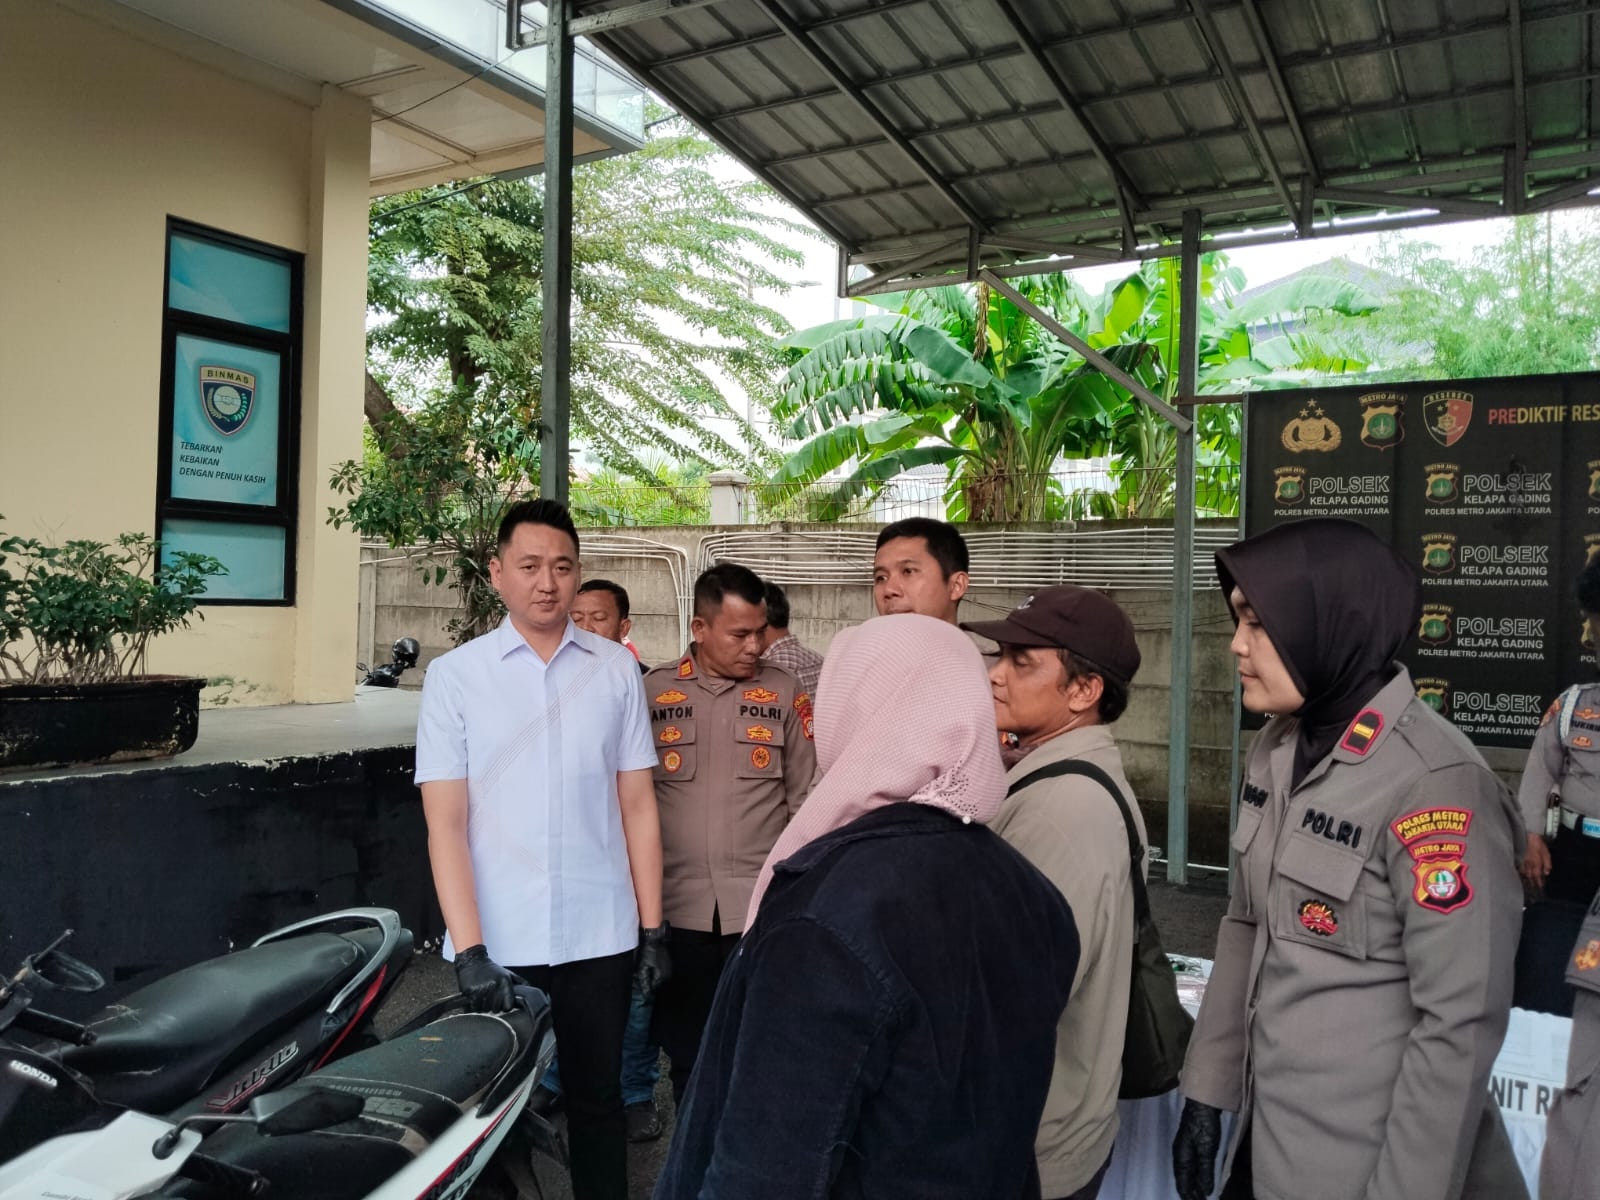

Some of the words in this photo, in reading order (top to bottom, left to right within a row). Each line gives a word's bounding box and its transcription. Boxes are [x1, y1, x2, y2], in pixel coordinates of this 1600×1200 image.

[207, 369, 249, 384] BINMAS
[1488, 406, 1567, 425] PREDIKTIF
[180, 441, 223, 454] TEBARKAN
[179, 454, 220, 466] KEBAIKAN
[179, 467, 214, 479] DENGAN
[215, 471, 242, 481] PENUH
[243, 475, 266, 484] KASIH
[1463, 473, 1552, 492] POLSEK
[1309, 476, 1390, 494] POLSEK
[1310, 497, 1348, 505] KELAPA
[1350, 496, 1389, 504] GADING
[1464, 495, 1506, 504] KELAPA
[1508, 494, 1551, 503] GADING
[1274, 508, 1302, 516] POLRES
[1364, 507, 1390, 515] UTARA
[1425, 508, 1456, 516] POLRES
[1457, 507, 1484, 515] METRO
[1486, 507, 1522, 515] JAKARTA
[1523, 506, 1552, 514] UTARA
[1460, 546, 1549, 564] POLSEK
[1461, 566, 1503, 575] KELAPA
[1505, 567, 1548, 576] GADING
[1422, 578, 1452, 586] POLRES
[1482, 579, 1519, 587] JAKARTA
[1520, 579, 1549, 587] UTARA
[1456, 617, 1545, 637] POLSEK
[1457, 637, 1499, 648] KELAPA
[1501, 638, 1544, 649] GADING
[1418, 648, 1449, 657] POLRES
[1450, 650, 1477, 659] METRO
[1478, 650, 1515, 660] JAKARTA
[1516, 652, 1544, 661] UTARA
[1580, 655, 1597, 663] POL
[1453, 692, 1542, 713] POLSEK
[739, 705, 782, 720] POLRI
[1453, 712, 1496, 724] KELAPA
[1498, 714, 1540, 726] GADING
[1475, 726, 1512, 735] JAKARTA
[1301, 808, 1362, 849] POLRI
[1397, 813, 1431, 833] POLRES
[1433, 810, 1467, 822] METRO
[1404, 823, 1436, 840] JAKARTA
[1437, 821, 1464, 831] UTARA
[1414, 844, 1440, 856] METRO
[10, 1060, 58, 1087] HONDA
[1491, 1075, 1529, 1112] NIT
